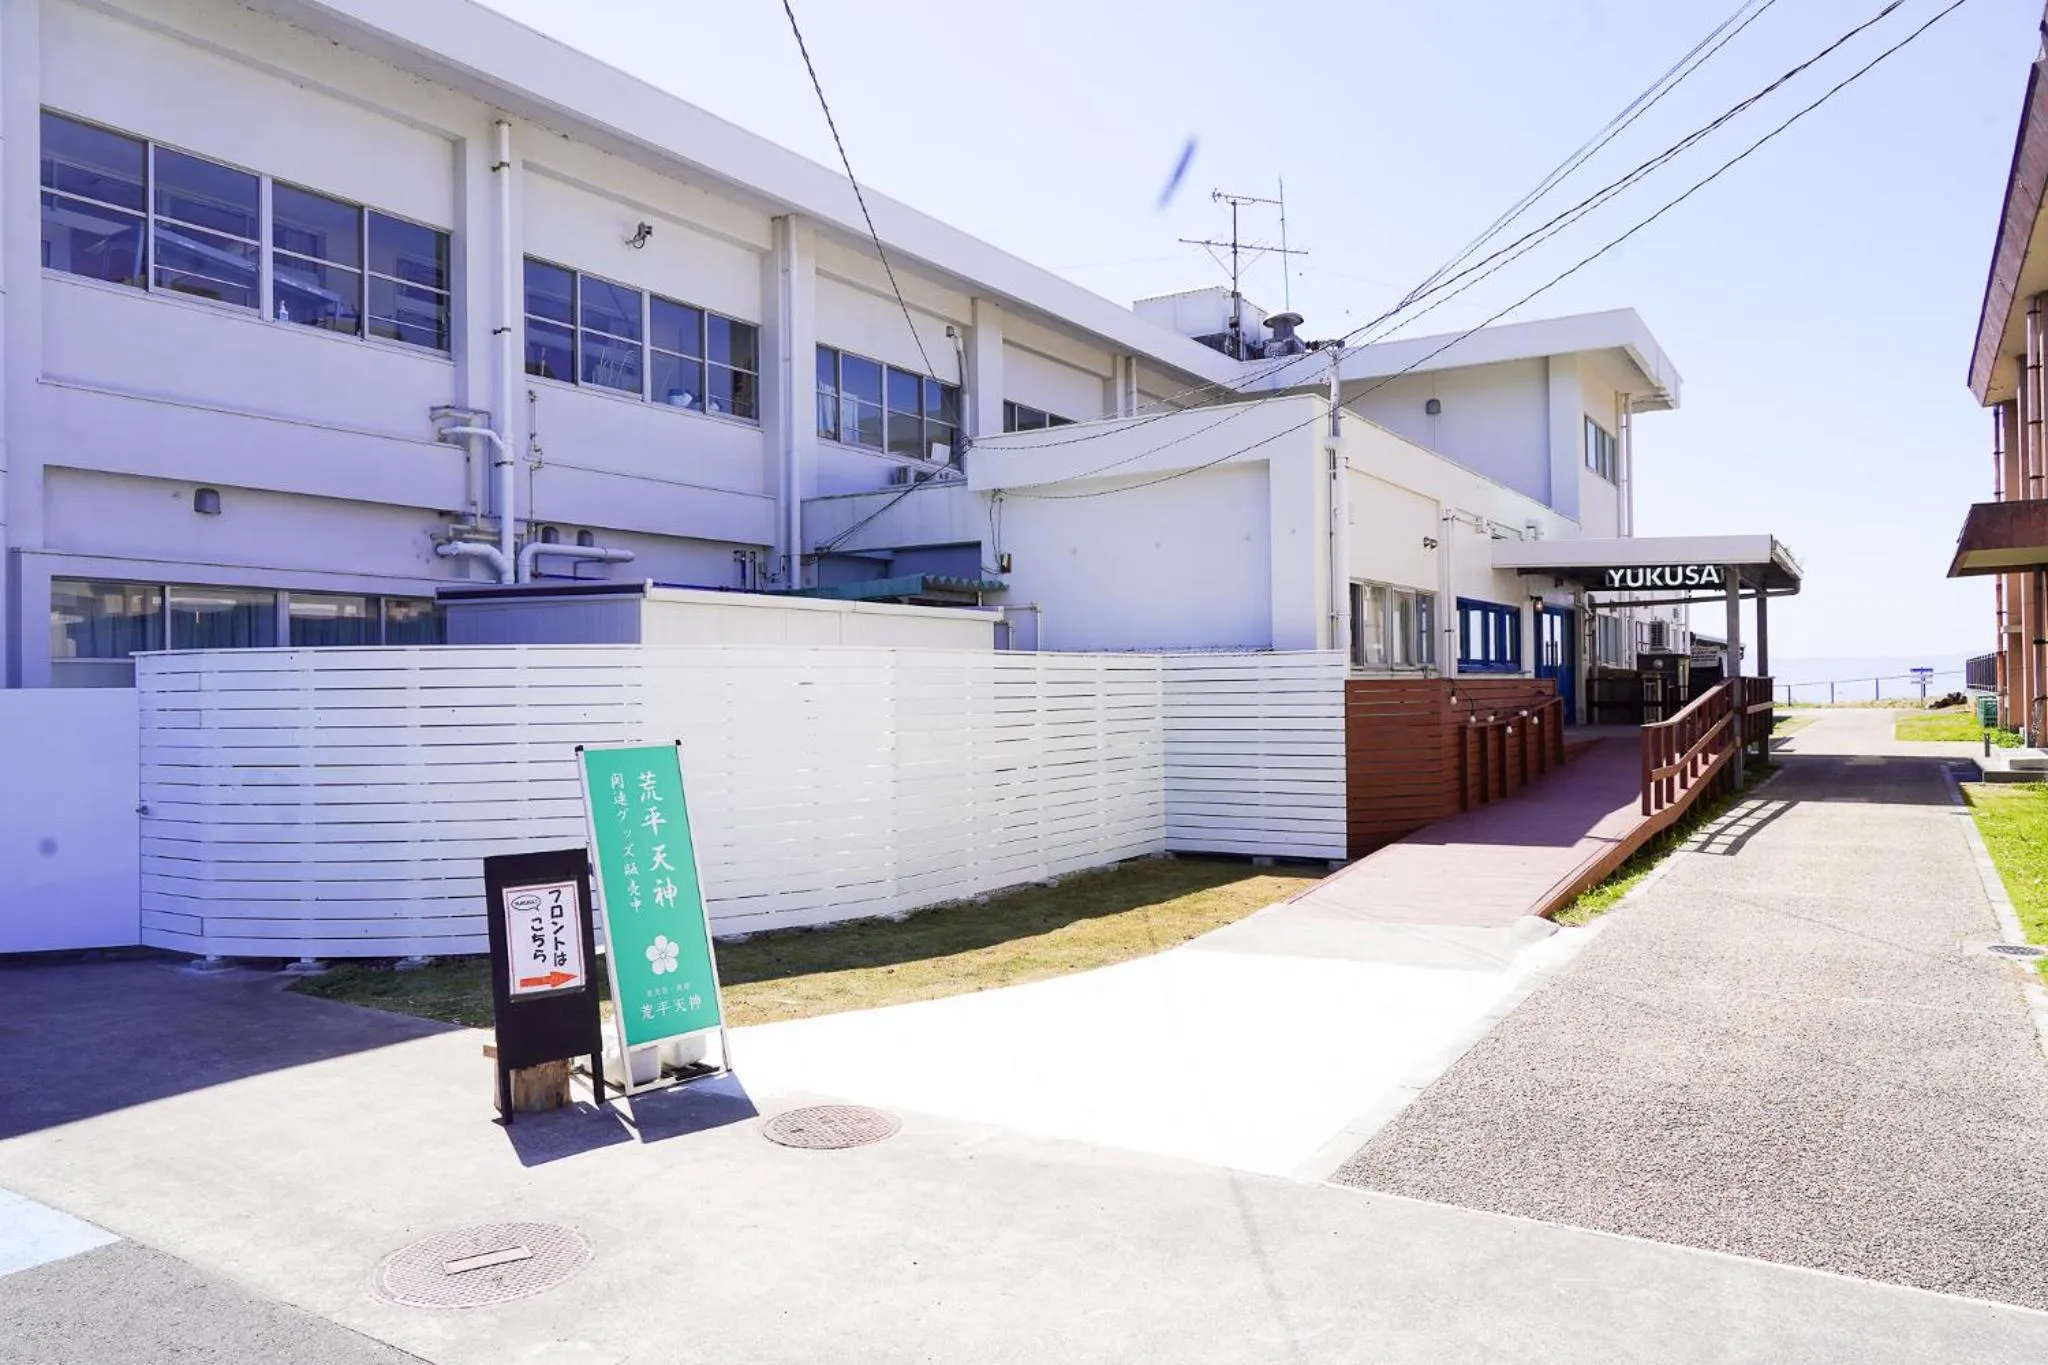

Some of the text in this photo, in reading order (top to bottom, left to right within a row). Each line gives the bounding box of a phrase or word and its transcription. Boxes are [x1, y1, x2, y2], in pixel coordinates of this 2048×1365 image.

[1608, 564, 1720, 588] YUKUSA
[610, 772, 642, 913] 関連グッズ販売中
[637, 770, 678, 909] 荒平天神
[530, 916, 547, 963] こちら
[548, 889, 567, 967] フロントは
[640, 993, 702, 1020] 荒平天神
